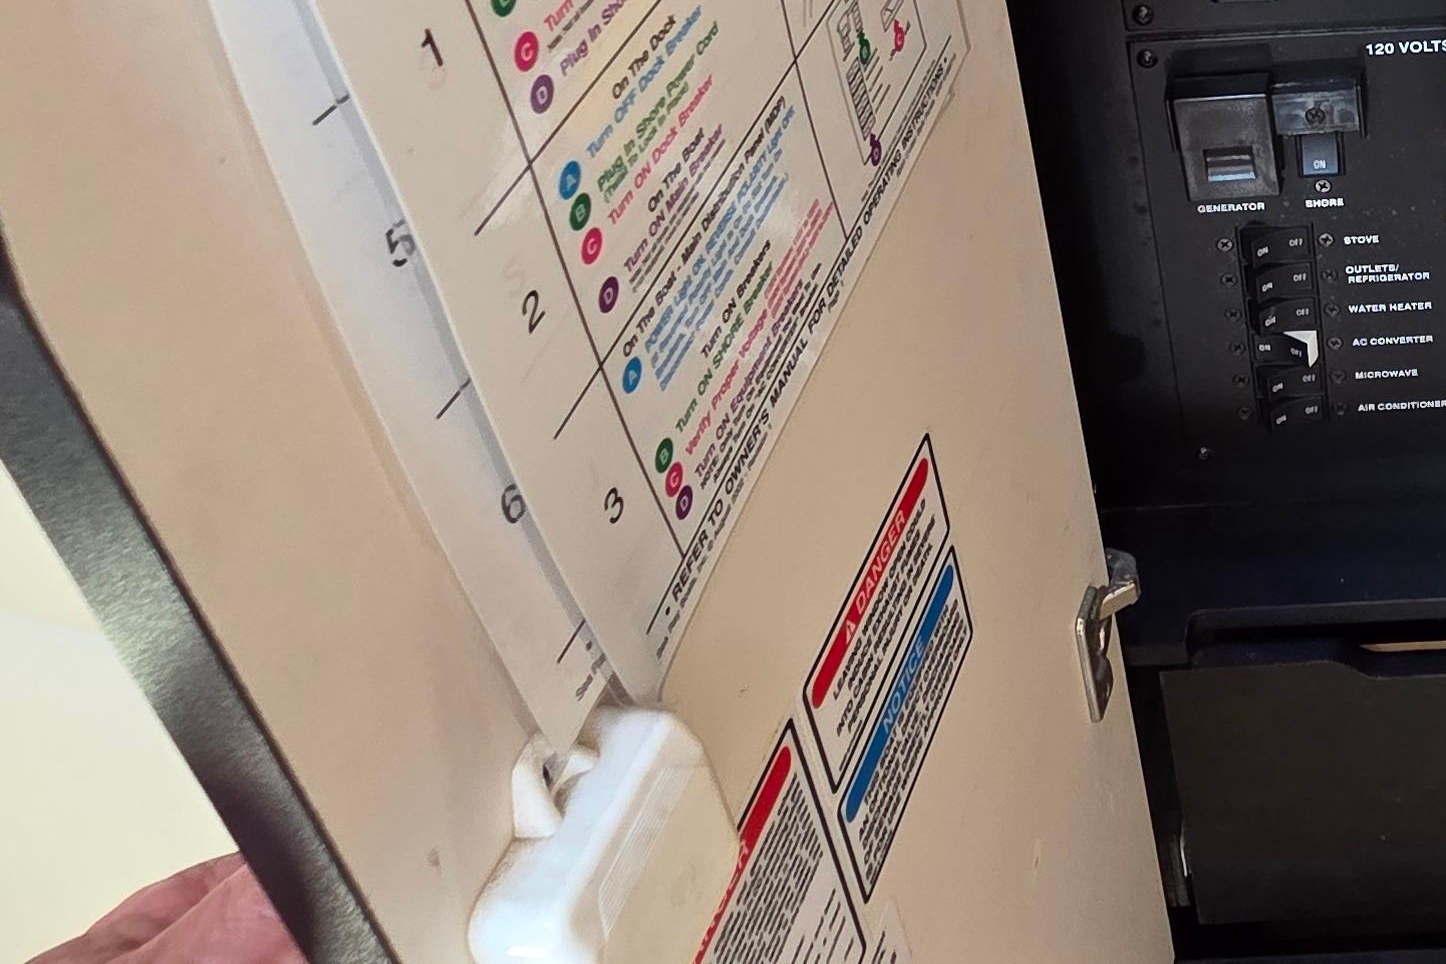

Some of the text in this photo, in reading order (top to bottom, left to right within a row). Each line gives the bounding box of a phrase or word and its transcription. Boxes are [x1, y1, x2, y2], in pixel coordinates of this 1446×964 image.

[421, 29, 442, 66] 1
[560, 39, 588, 75] Plug
[587, 23, 601, 41] In
[1366, 44, 1394, 55] 120
[612, 15, 675, 99] On The Dock
[1313, 160, 1326, 169] ON
[1198, 202, 1265, 213] GENERATOR
[1305, 198, 1344, 208] SHORE
[385, 219, 416, 268] 5
[1344, 236, 1379, 244] STOVE
[1346, 264, 1399, 274] OUTLETS/
[1349, 272, 1430, 284] REFRIGERATOR
[522, 289, 544, 333] 2
[1349, 302, 1432, 313] WATER HEATER
[672, 529, 707, 601] REFER
[708, 498, 723, 525] TO
[725, 409, 768, 494] OWNER'S
[770, 339, 807, 407] MANUAL
[808, 297, 826, 333] FOR
[826, 226, 862, 297] DETAILED
[863, 149, 901, 224] OPERATING
[901, 63, 943, 148] INSTRUCTIONS
[1353, 336, 1433, 346] AC CONVERTER
[1355, 369, 1418, 379] MICROWAVE
[1358, 403, 1375, 411] AIR
[501, 484, 525, 524] 6
[604, 487, 623, 523] 3
[856, 510, 904, 613] DANGER
[883, 636, 923, 732] NOTICE
